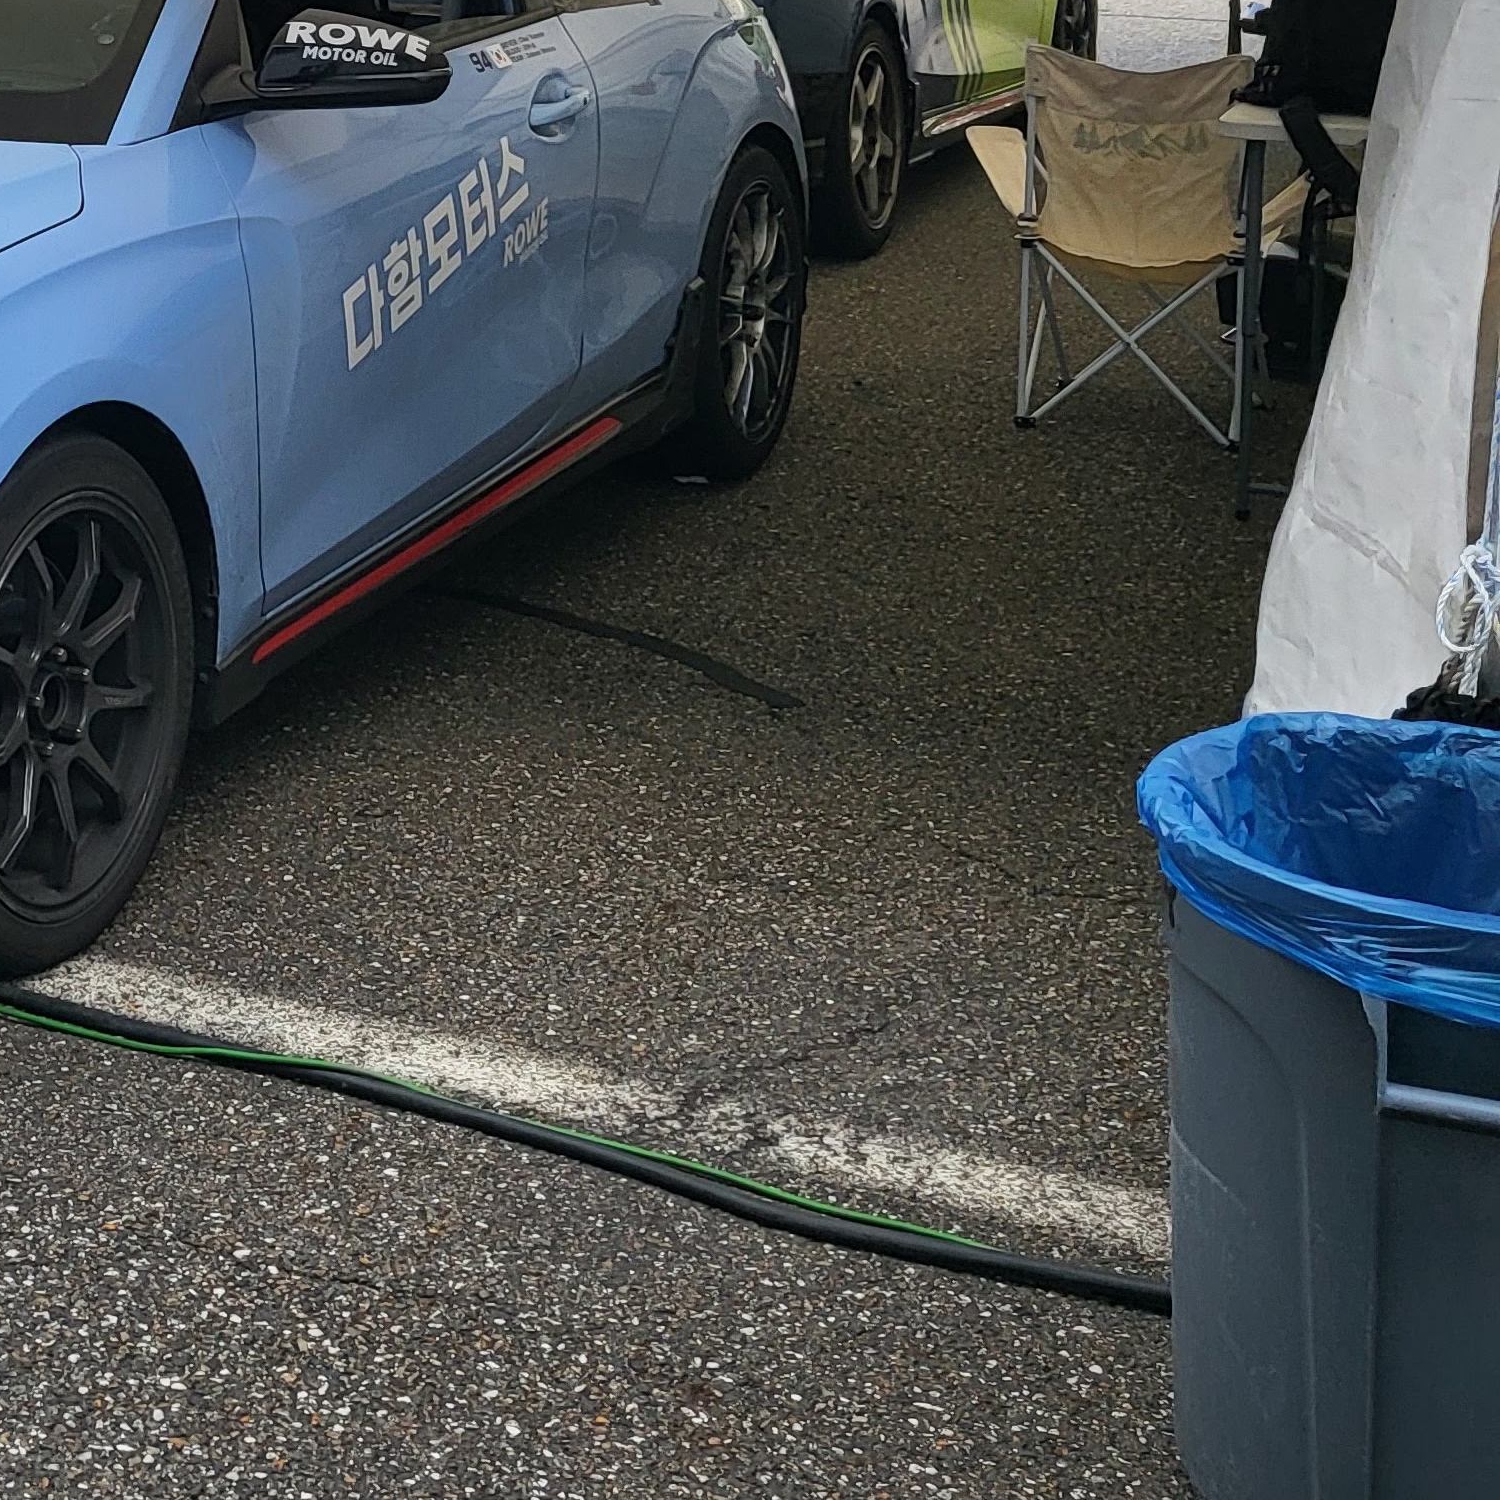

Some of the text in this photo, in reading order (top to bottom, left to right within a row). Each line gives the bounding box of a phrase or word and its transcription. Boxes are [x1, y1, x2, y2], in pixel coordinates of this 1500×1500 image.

[285, 21, 431, 62] ROWE
[302, 45, 398, 67] MOTOR OIL
[469, 50, 494, 73] 94
[503, 197, 549, 268] ROWE
[342, 136, 530, 371] 다함모터스
